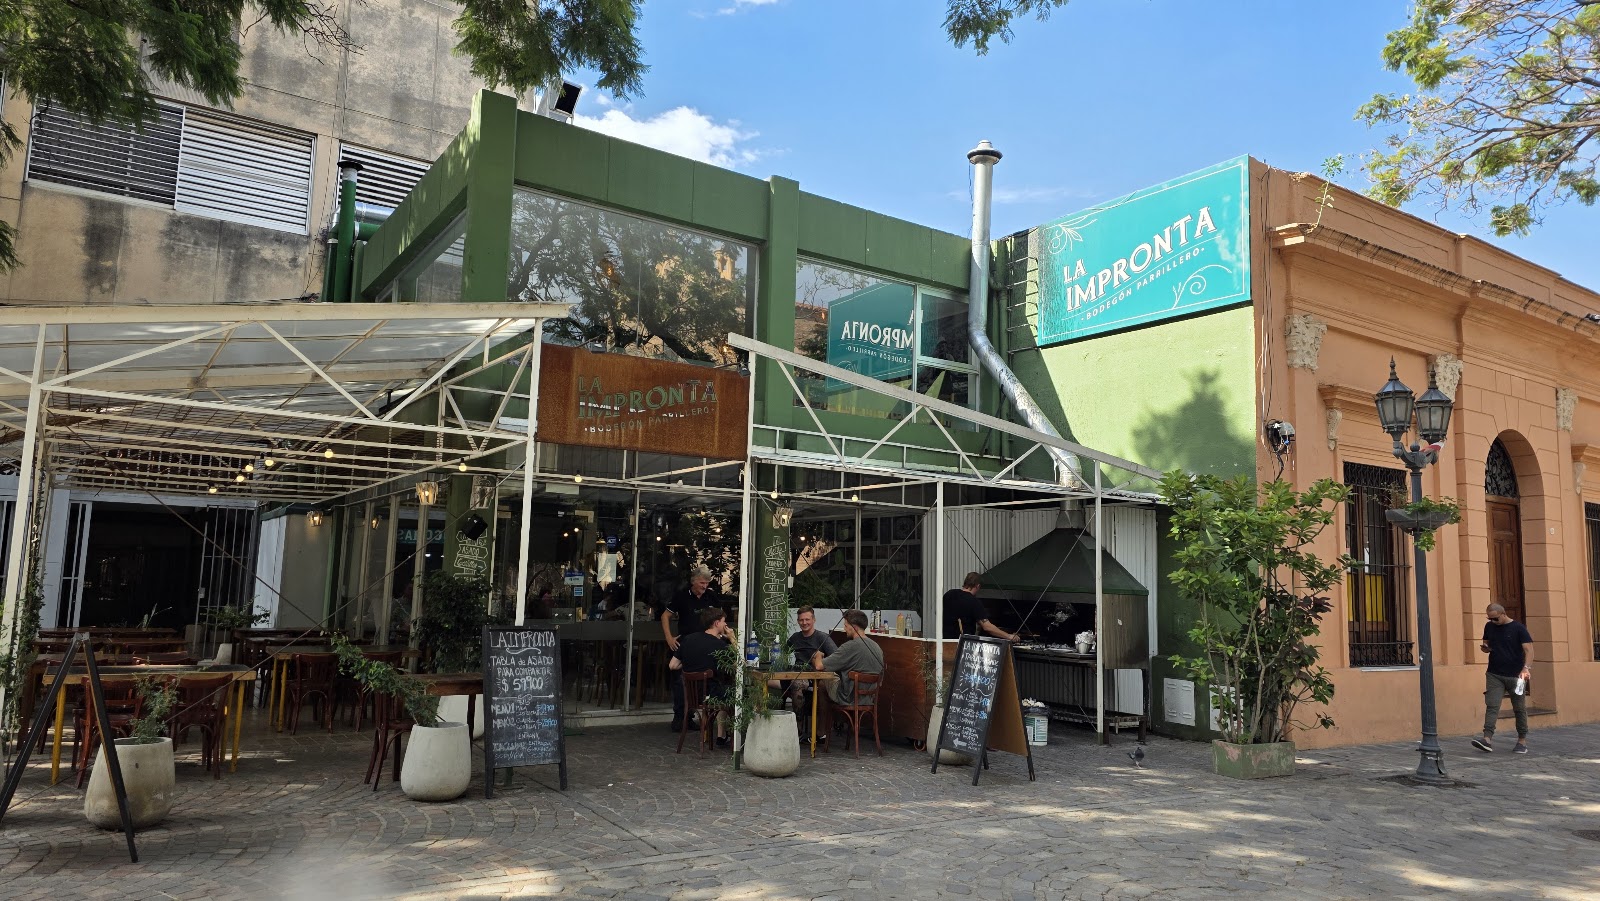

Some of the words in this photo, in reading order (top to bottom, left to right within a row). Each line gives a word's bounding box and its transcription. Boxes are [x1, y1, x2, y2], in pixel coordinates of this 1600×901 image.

[1066, 206, 1217, 312] IMPRONTA
[1063, 258, 1087, 284] LA
[1085, 288, 1132, 320] BODEGÓN
[1136, 248, 1199, 290] PARRILLERO
[578, 376, 602, 395] LA
[578, 379, 717, 419] IMPRONTA
[963, 641, 971, 650] LA
[490, 655, 516, 667] TABLA
[518, 657, 526, 666] de
[527, 655, 554, 666] ASADO
[497, 667, 514, 677] PARA
[515, 667, 552, 676] COMPARTIR
